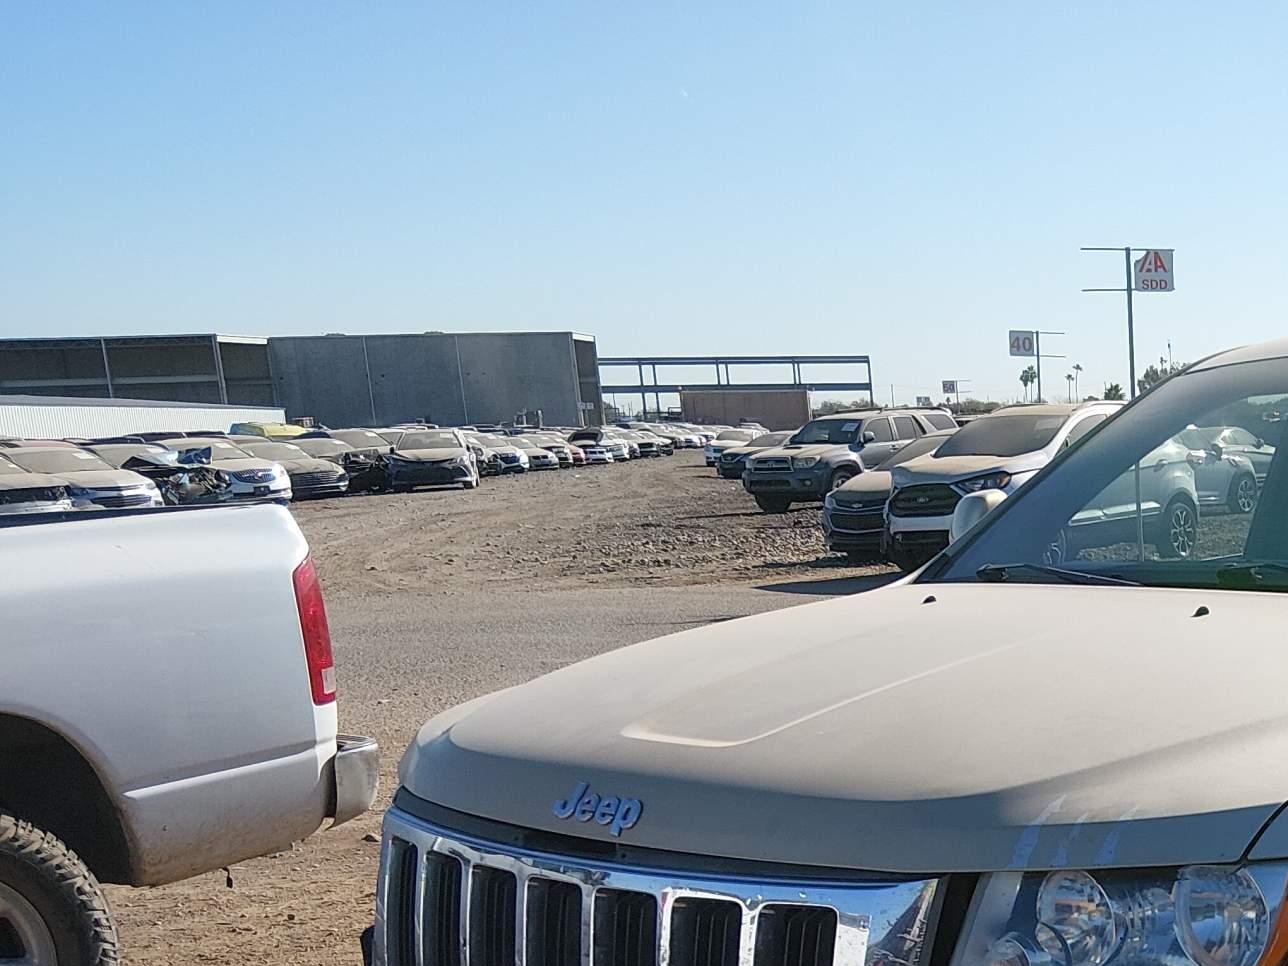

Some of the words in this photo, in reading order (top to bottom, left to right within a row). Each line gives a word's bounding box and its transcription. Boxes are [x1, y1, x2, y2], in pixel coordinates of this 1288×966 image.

[1142, 279, 1168, 290] SDD
[1011, 336, 1032, 352] 40
[552, 782, 644, 837] Jeep
